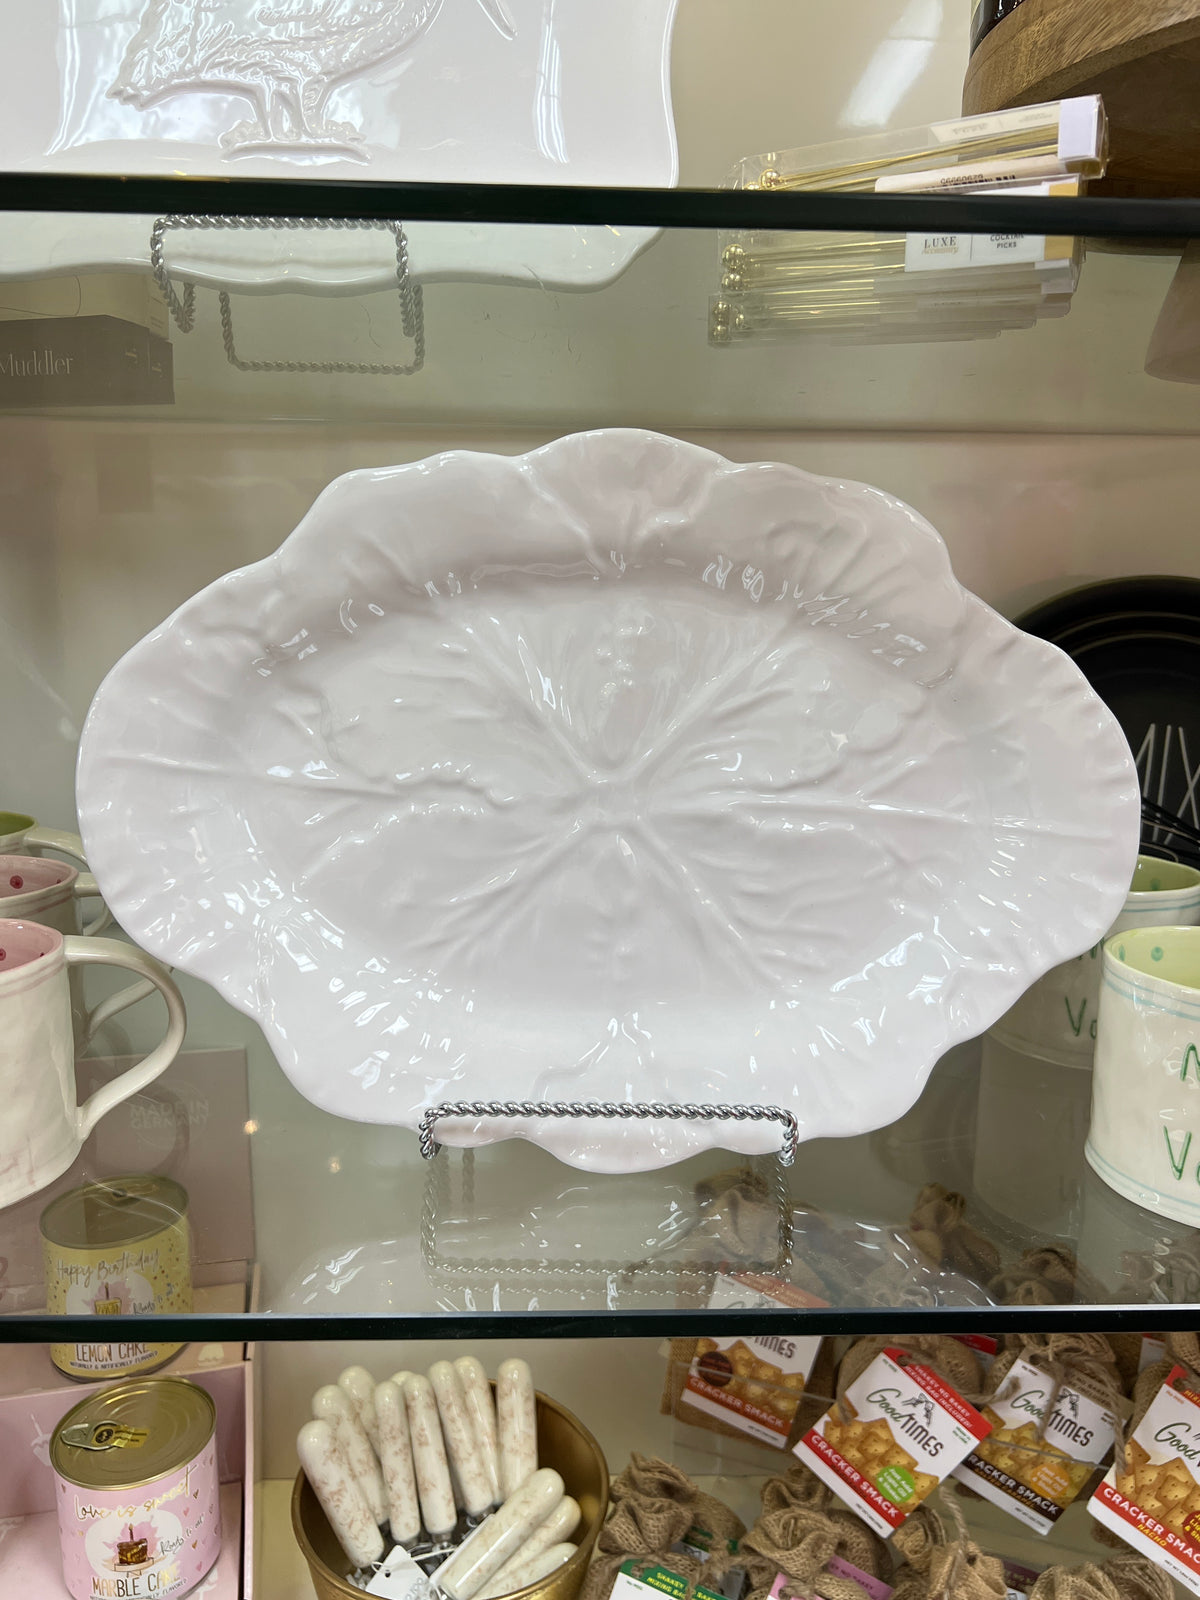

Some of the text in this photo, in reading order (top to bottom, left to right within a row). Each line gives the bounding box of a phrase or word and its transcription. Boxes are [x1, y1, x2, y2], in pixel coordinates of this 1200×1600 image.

[924, 236, 957, 249] LUXE
[996, 241, 1017, 249] PICKS
[57, 1250, 160, 1288] Happy Birthday
[76, 1342, 150, 1363] LEMON CAKE
[690, 1376, 783, 1427] CRACKER SMACK
[866, 1387, 912, 1423] Good
[900, 1413, 944, 1457] TIMES
[1048, 1409, 1095, 1447] TIMES
[1153, 1421, 1200, 1461] Good
[810, 1434, 862, 1483] CRACKER
[861, 1480, 899, 1519] SMACK
[968, 1453, 1061, 1515] RACKER SMACK
[1102, 1486, 1164, 1536] CRACKER
[1136, 1523, 1168, 1547] NACHO
[92, 1560, 180, 1598] MARBLE CAKE
[656, 1572, 685, 1589] SHAKEY
